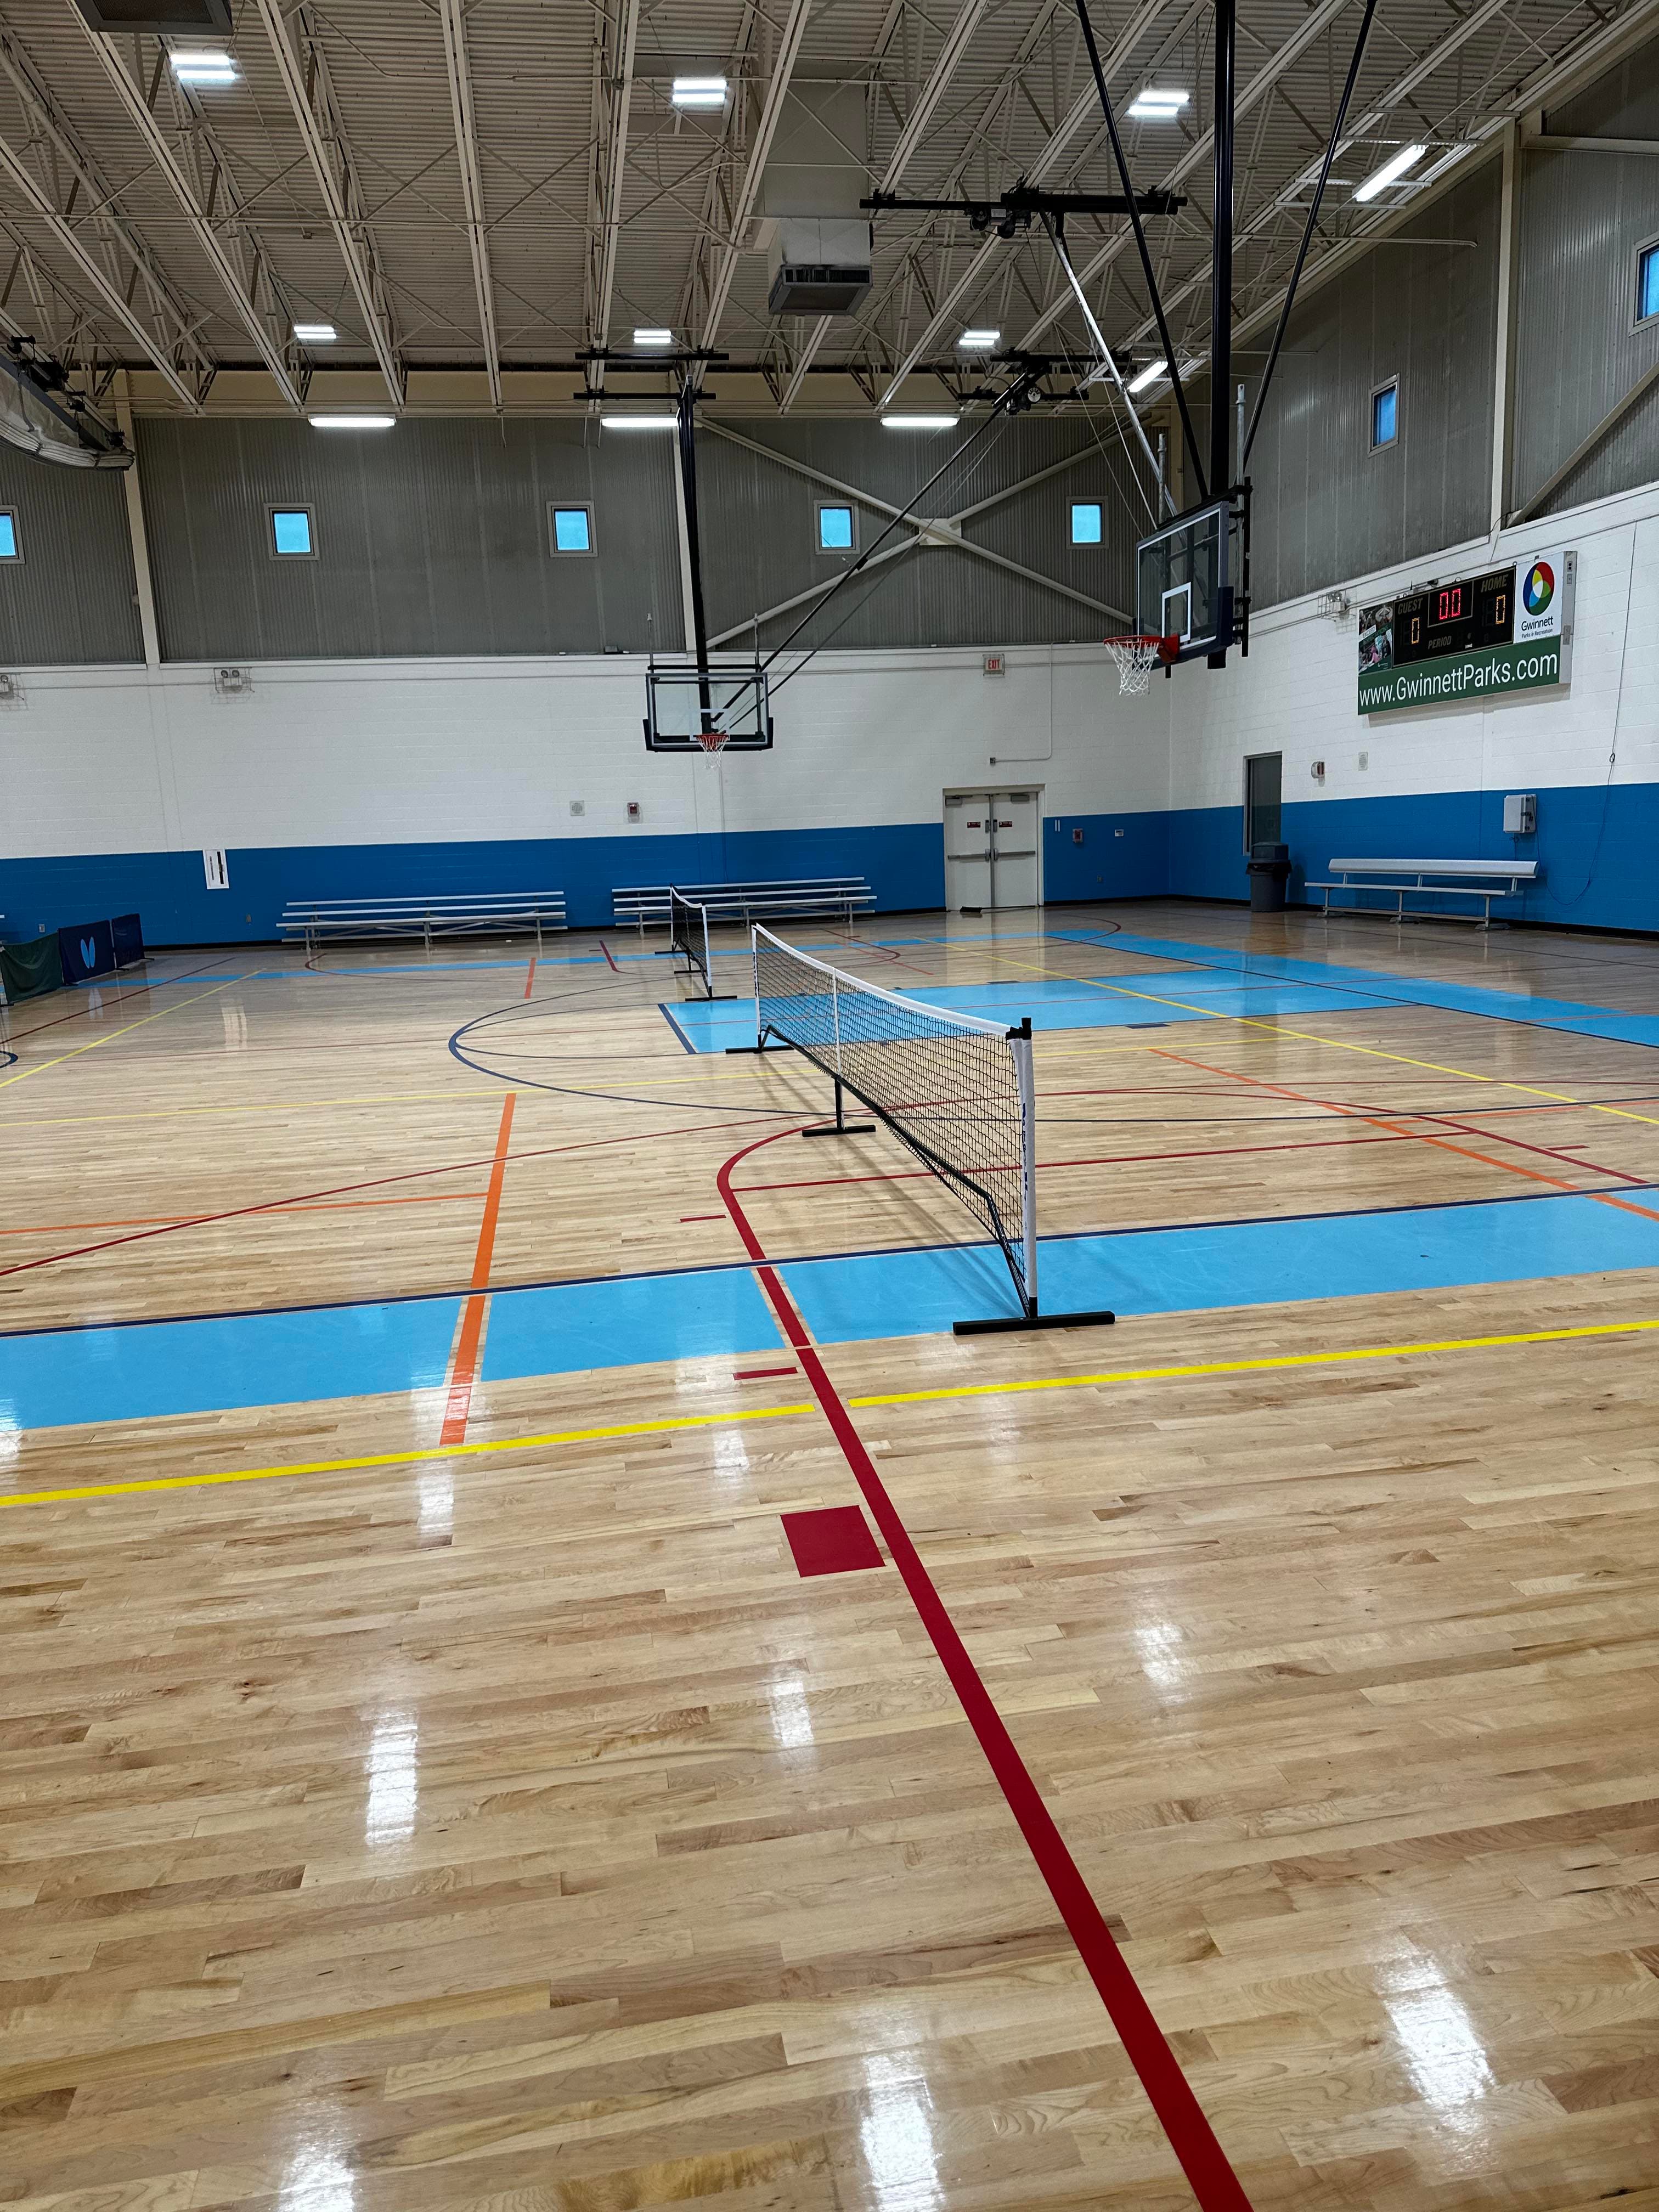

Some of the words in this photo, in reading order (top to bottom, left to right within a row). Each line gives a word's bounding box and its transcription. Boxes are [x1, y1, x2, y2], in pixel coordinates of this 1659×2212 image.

[1481, 574, 1509, 592] HOME
[1397, 597, 1424, 615] GUEST
[1495, 595, 1506, 625] 0
[1411, 617, 1420, 645] 0
[1521, 616, 1554, 631] Gwinnett
[1427, 635, 1452, 650] PERIOD
[988, 659, 1001, 669] EXIT
[1359, 653, 1558, 707] www.GwinnettParks.com
